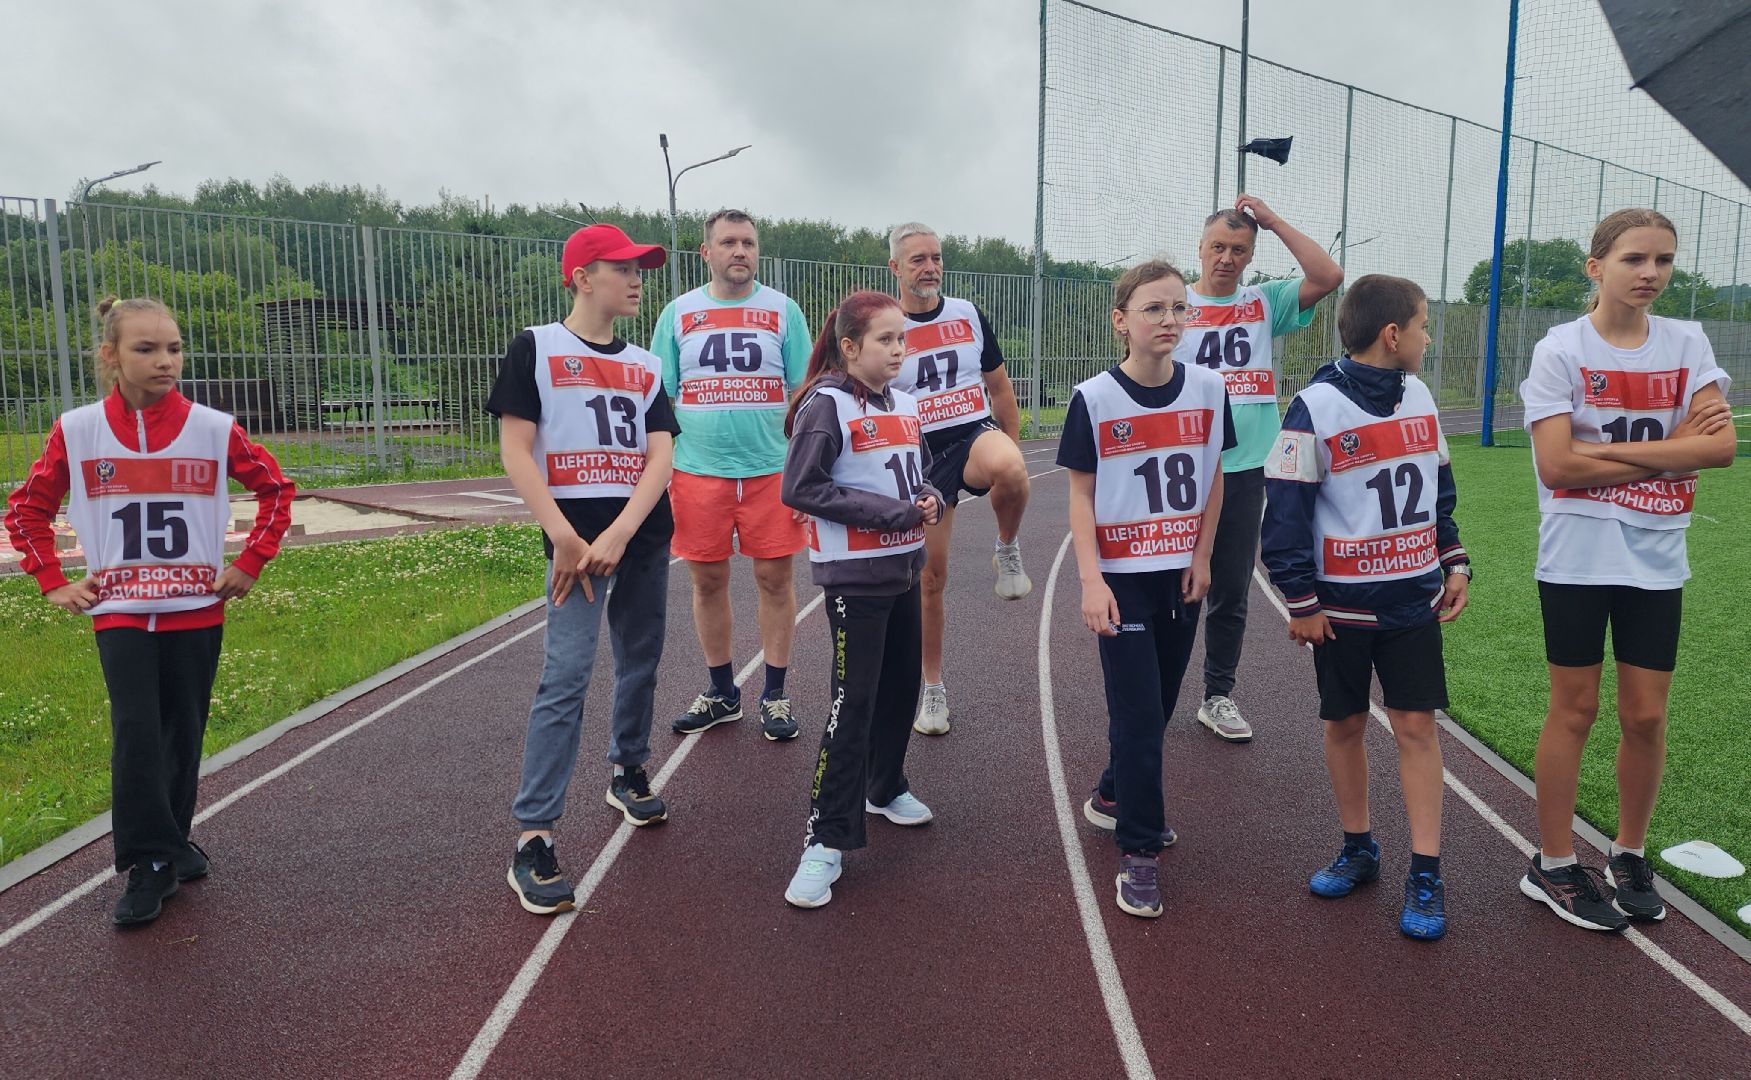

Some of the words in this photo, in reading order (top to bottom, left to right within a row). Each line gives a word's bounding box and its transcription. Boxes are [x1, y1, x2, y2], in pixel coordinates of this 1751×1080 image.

[743, 308, 770, 325] ГТО
[938, 320, 966, 340] ГТО
[698, 332, 763, 373] 45
[1196, 326, 1251, 369] 46
[916, 349, 959, 393] 47
[1225, 372, 1251, 383] ФСК
[1253, 371, 1269, 383] ГТО
[686, 380, 720, 393] ЦЕНТР
[722, 378, 760, 390] ВФСК
[762, 379, 780, 390] ГТО
[1226, 383, 1258, 395] ЦОВО
[697, 391, 768, 404] ОДИНЦОВО
[934, 392, 967, 408] ВФСК
[967, 387, 981, 400] ГТО
[585, 394, 638, 449] 13
[919, 401, 975, 426] ДИНЦОВО
[1399, 418, 1430, 444] ГТО
[171, 459, 210, 484] ГТО
[554, 454, 608, 470] ЦЕНТР
[576, 470, 641, 485] ОДИНЦО
[884, 451, 924, 501] 14
[1133, 452, 1198, 514] 18
[1365, 462, 1430, 531] 12
[111, 501, 189, 561] 15
[1105, 523, 1158, 542] ЦЕНТР
[1130, 535, 1198, 556] ОДИНЦО
[1333, 539, 1391, 558] ЦЕНТР
[1395, 531, 1432, 552] ВФСК
[138, 567, 194, 582] ВФСК
[98, 582, 207, 601] ОДИНЦОВО
